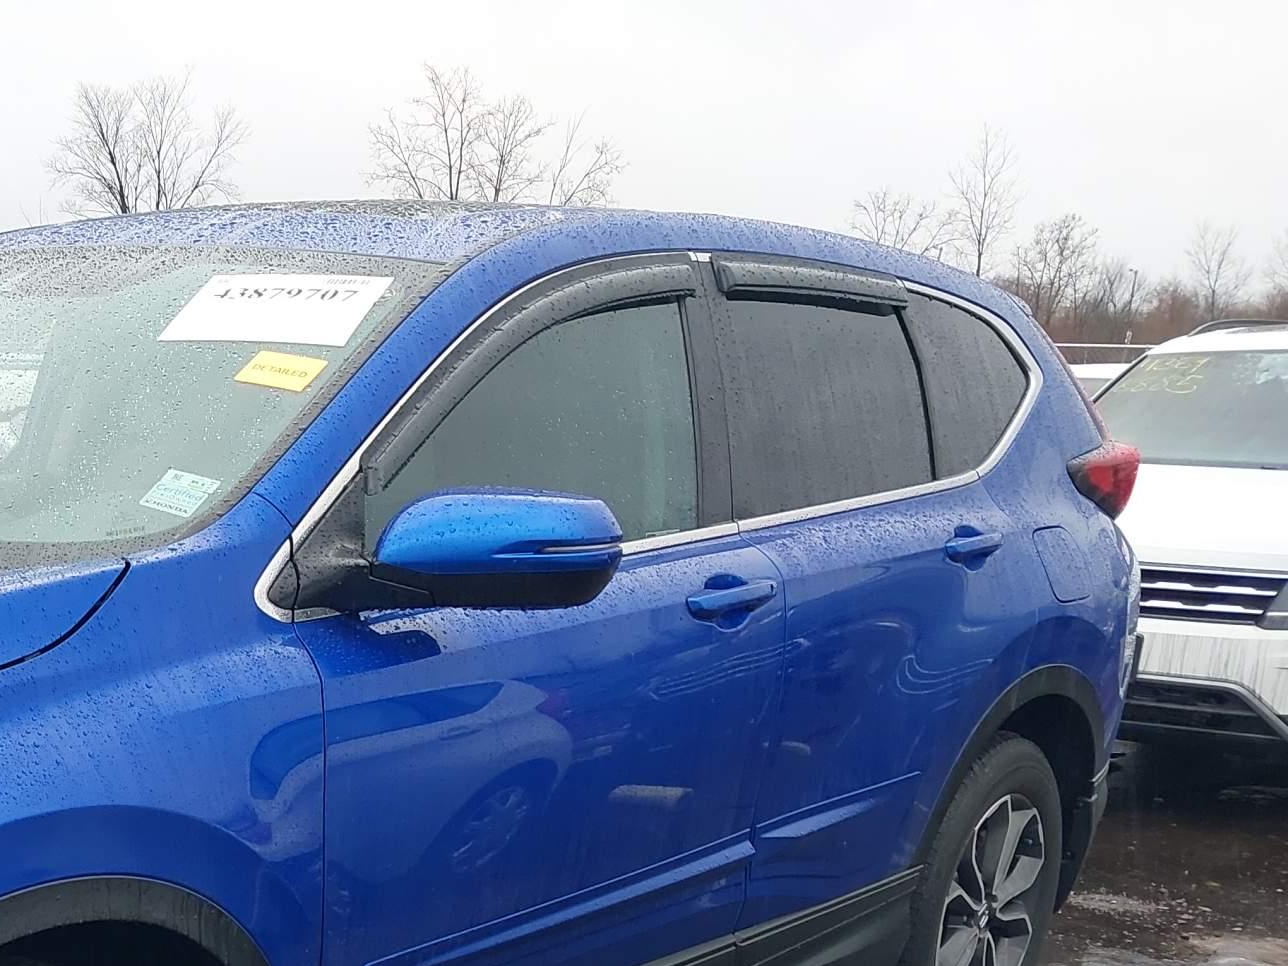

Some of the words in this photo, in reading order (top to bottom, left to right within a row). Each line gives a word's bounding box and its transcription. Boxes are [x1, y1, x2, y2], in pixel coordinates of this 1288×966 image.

[213, 287, 360, 302] 43879707
[252, 362, 308, 379] DETAILED
[151, 499, 189, 514] HONDA
